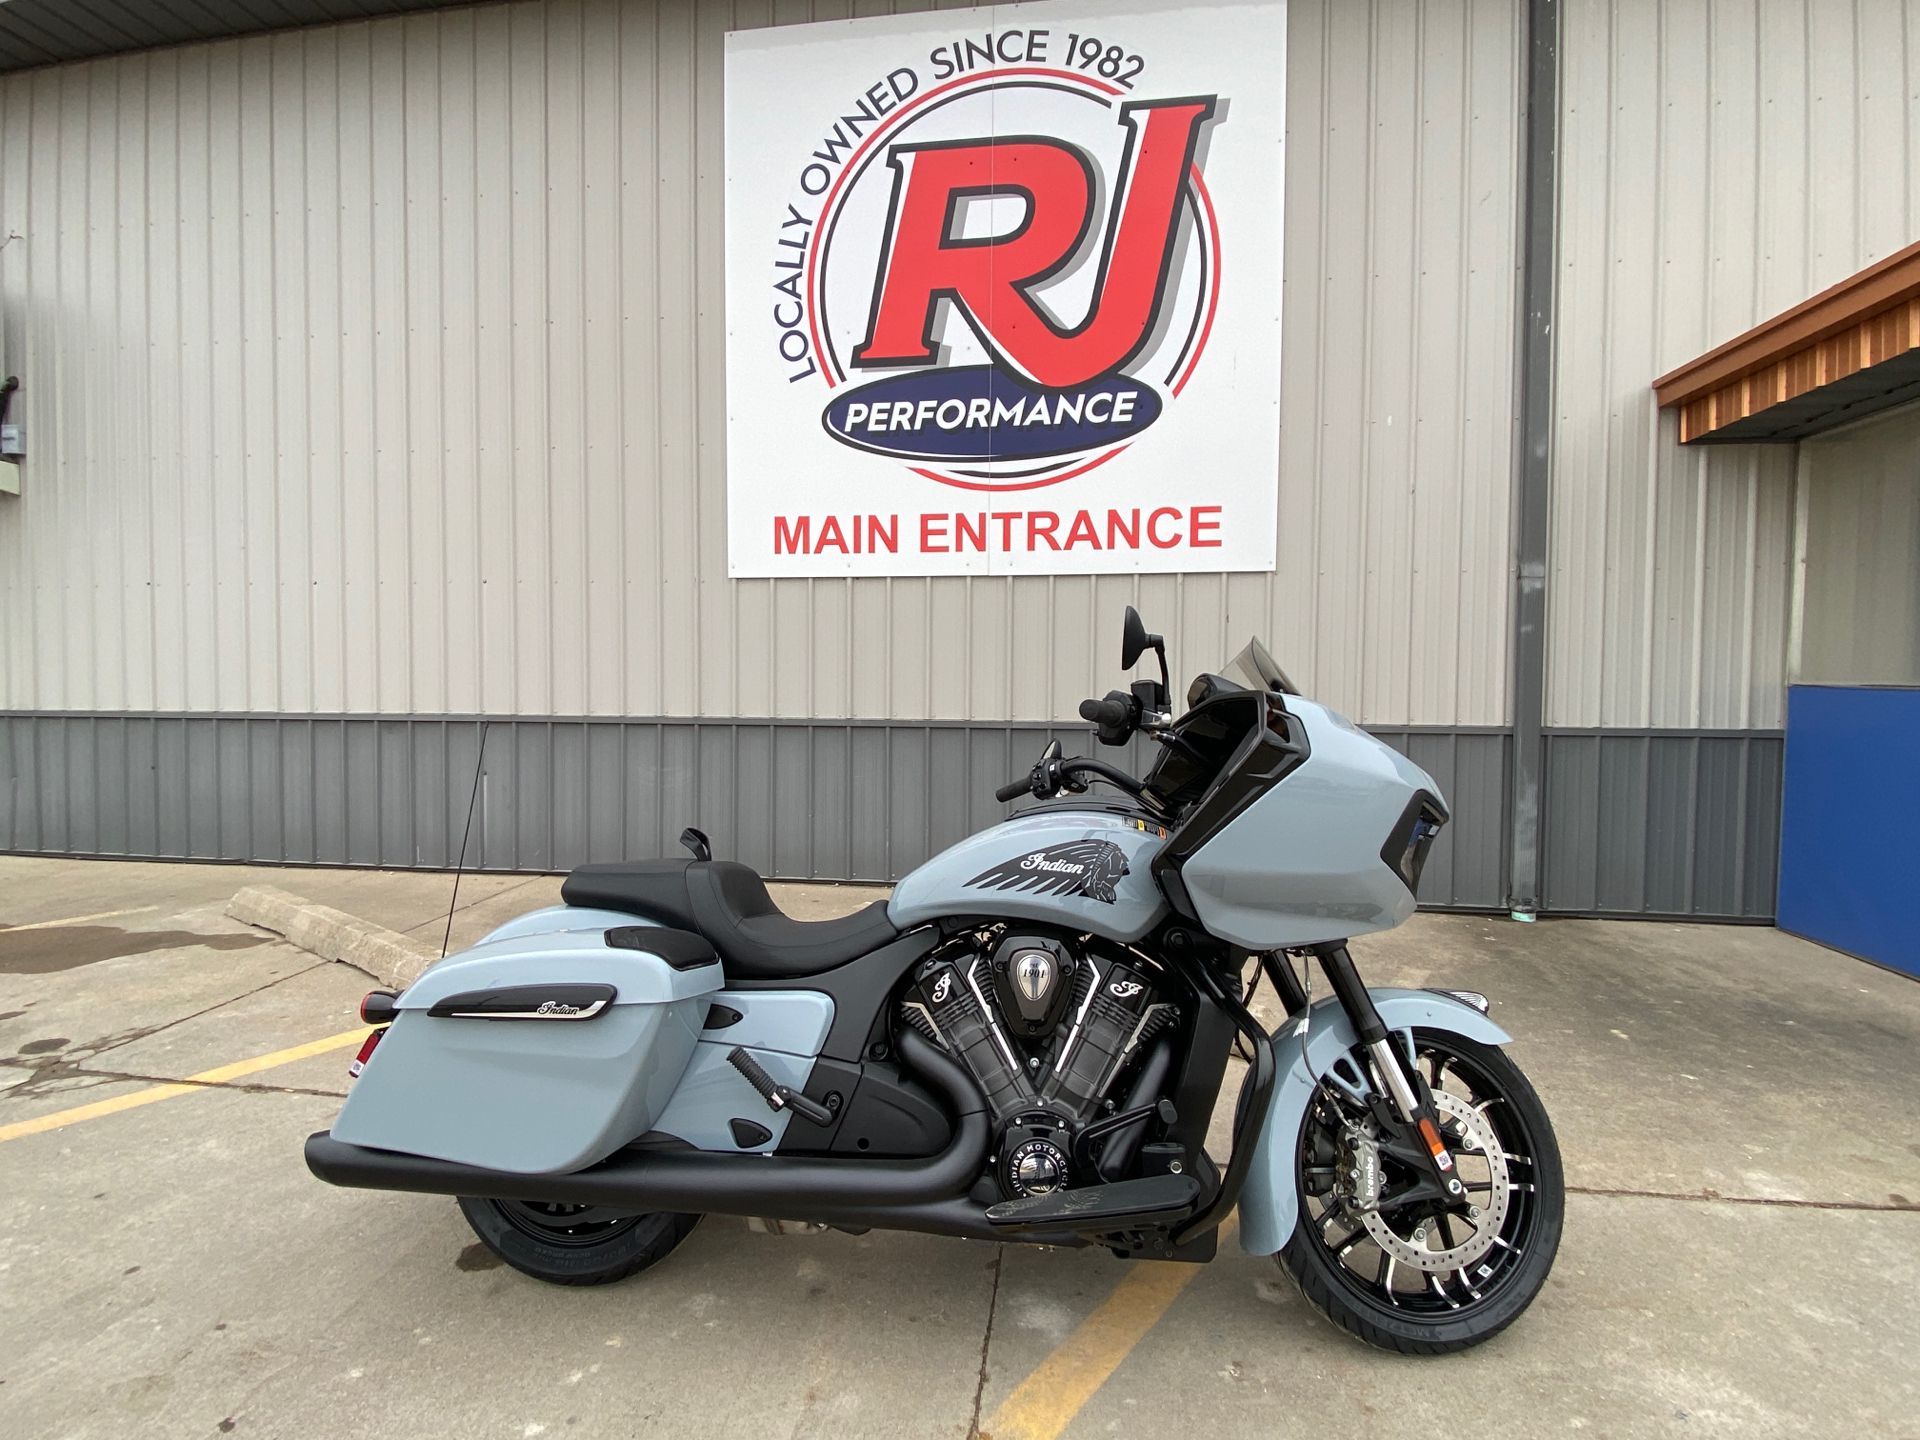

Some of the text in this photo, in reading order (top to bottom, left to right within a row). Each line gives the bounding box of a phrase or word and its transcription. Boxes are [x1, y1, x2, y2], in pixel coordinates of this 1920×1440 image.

[773, 30, 1145, 383] LOCALLY OWNED SINCE 1982
[850, 94, 1219, 389] RJ
[844, 391, 1139, 433] PERFORMANCE
[773, 505, 1223, 555] MAIN ENTRANCE
[1020, 852, 1084, 875] Indian
[1023, 968, 1045, 979] 1901
[537, 1001, 579, 1016] Indian
[1365, 1155, 1374, 1197] brembo
